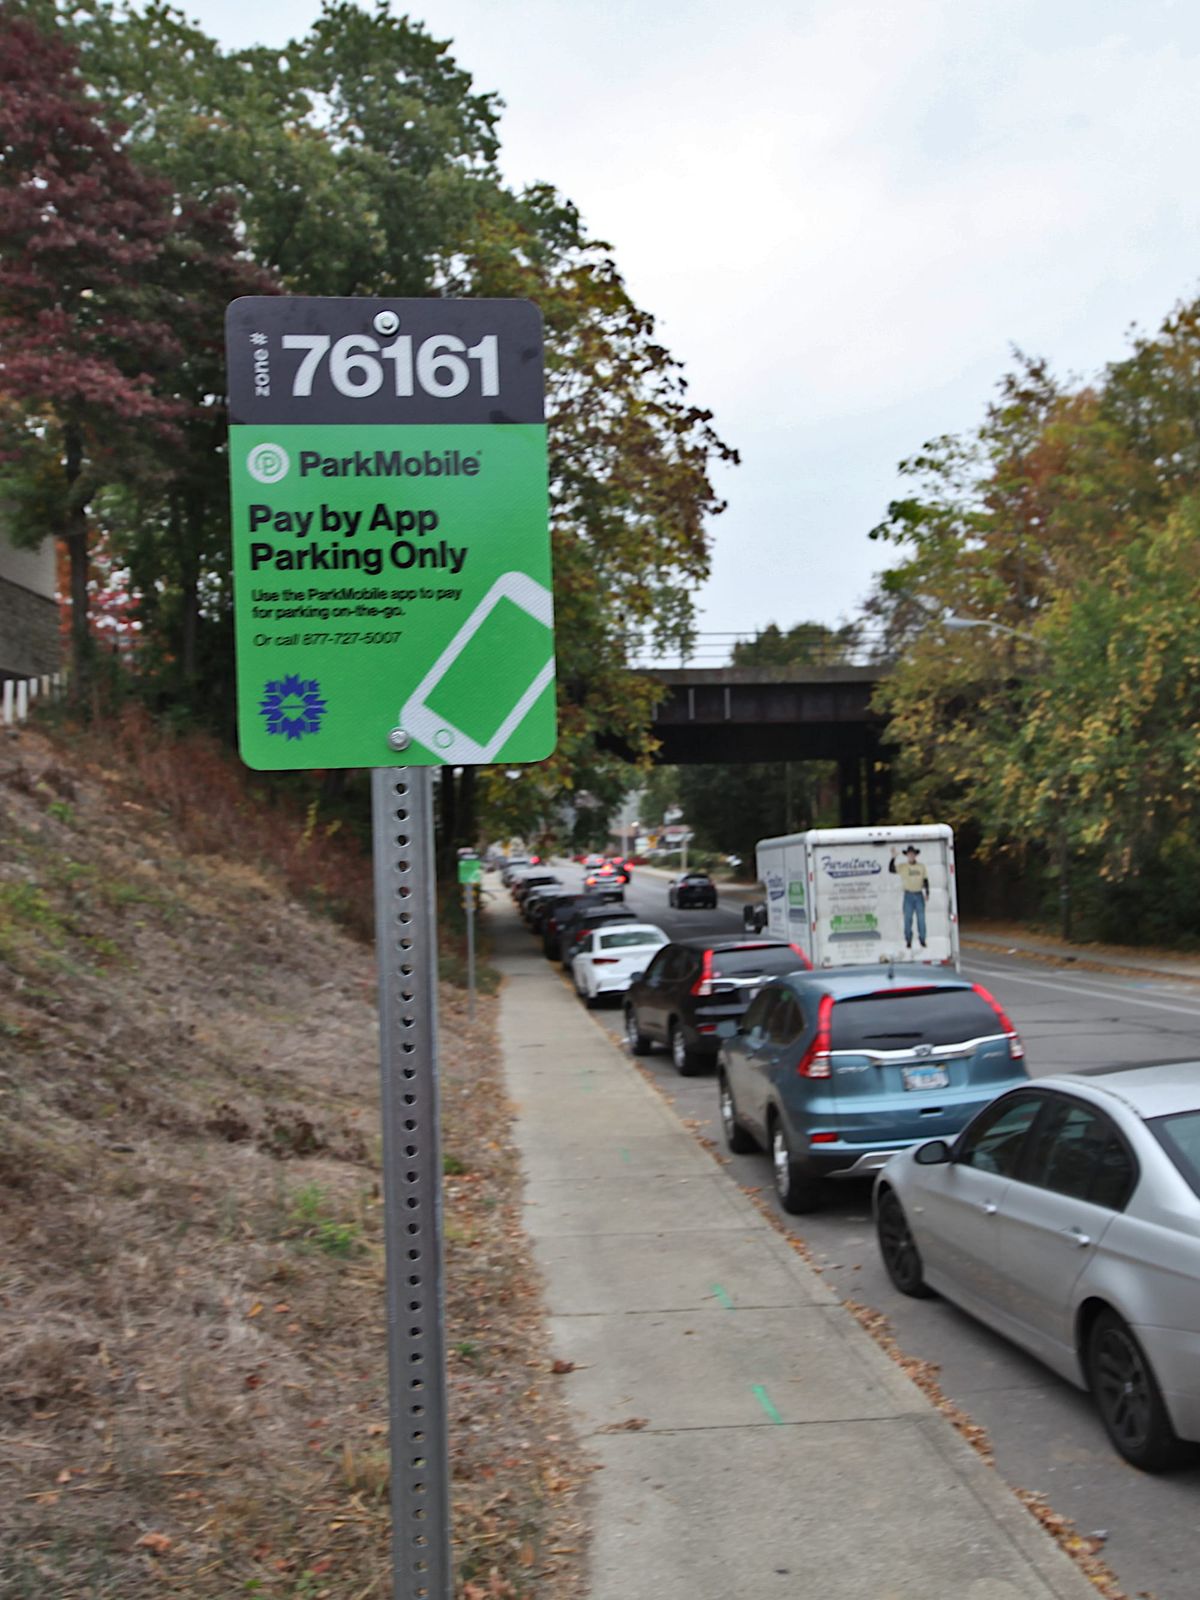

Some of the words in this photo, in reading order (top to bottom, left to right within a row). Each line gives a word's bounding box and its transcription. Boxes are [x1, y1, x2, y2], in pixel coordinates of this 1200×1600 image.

[253, 348, 270, 397] zone
[281, 334, 500, 398] 76161
[299, 450, 480, 477] ParkMobile
[248, 504, 314, 538] Pay
[320, 504, 363, 537] by
[368, 503, 439, 536] App
[250, 541, 384, 575] Parking
[390, 540, 468, 574] Only
[251, 588, 279, 601] Use
[282, 588, 305, 600] the
[307, 587, 388, 600] ParkMobile
[390, 589, 417, 601] app
[419, 587, 434, 599] to
[436, 588, 462, 601] pay
[252, 606, 273, 618] for
[275, 605, 329, 620] parking
[253, 633, 272, 646] Or
[275, 633, 299, 646] call
[302, 631, 402, 645] 877-727-5007
[821, 856, 878, 871] Furniture
